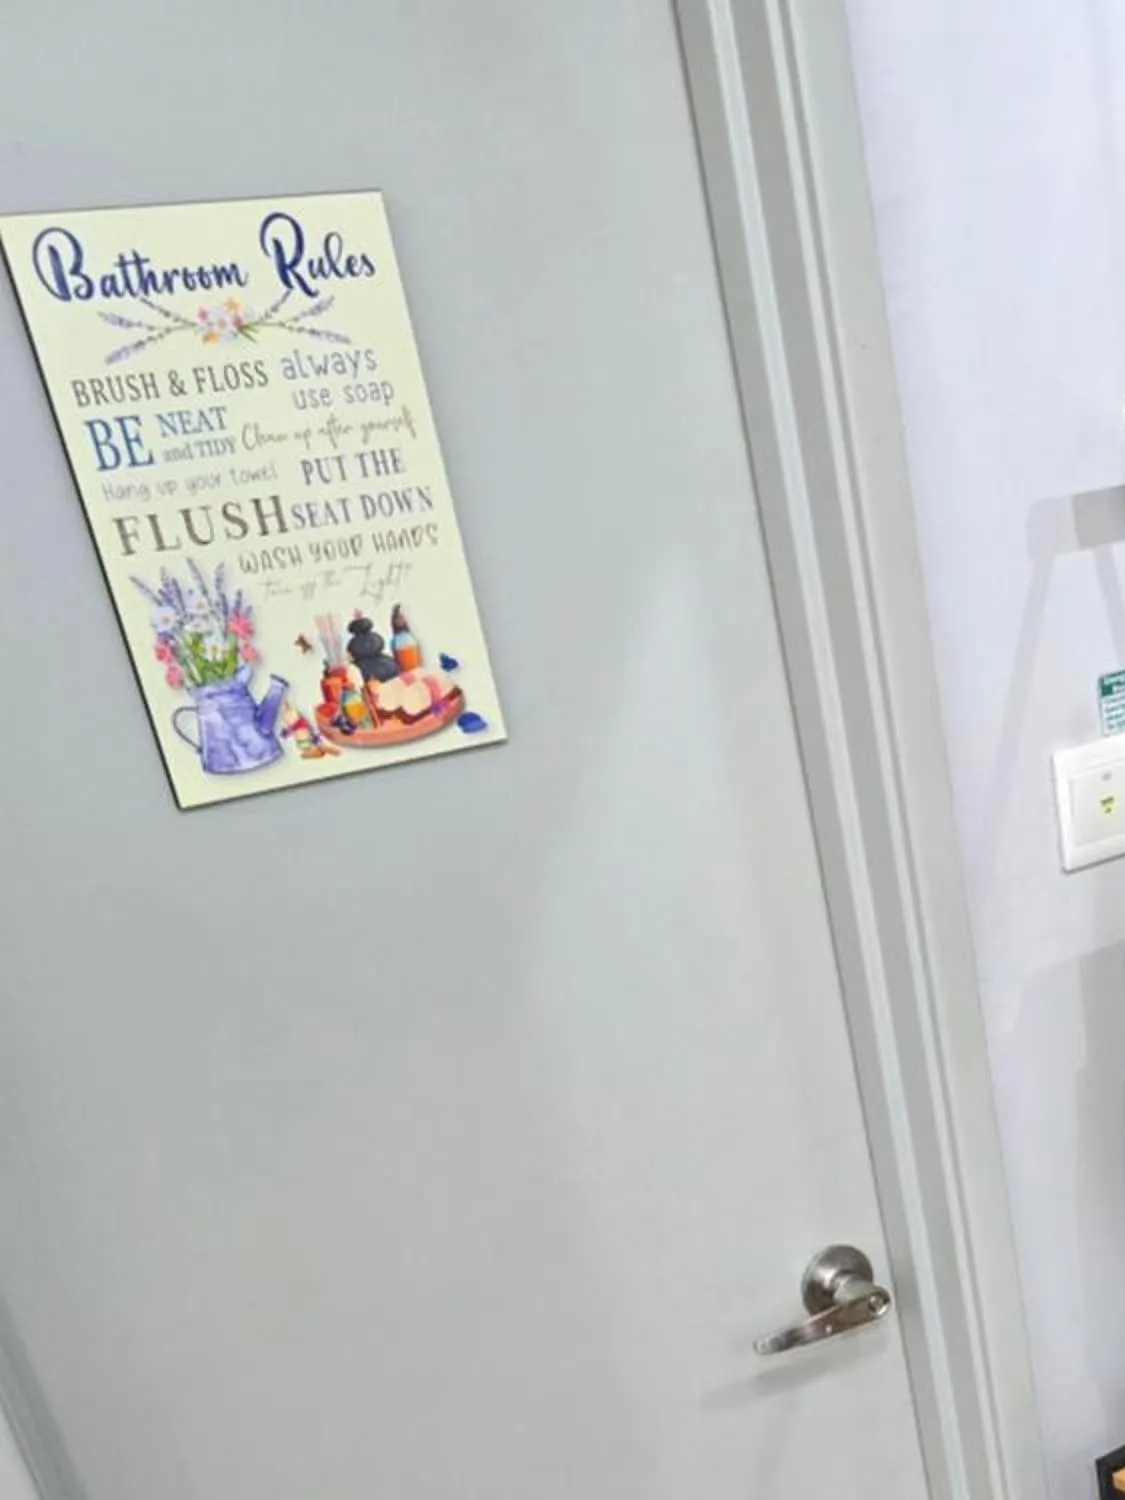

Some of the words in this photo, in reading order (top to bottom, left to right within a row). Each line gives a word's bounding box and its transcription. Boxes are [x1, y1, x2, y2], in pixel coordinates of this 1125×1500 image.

[32, 226, 248, 301] Bathroom
[260, 212, 376, 298] Rules
[281, 349, 378, 380] always
[70, 372, 160, 408] BRUSH
[167, 369, 188, 397] &
[192, 360, 269, 394] FLOSS
[291, 387, 334, 411] use
[342, 380, 395, 407] soap
[155, 406, 228, 438] NEAT
[83, 415, 155, 472] BE
[195, 436, 238, 458] TIDY
[300, 455, 349, 486] PUT
[354, 448, 407, 479] THE
[112, 495, 290, 557] FLUSH
[291, 498, 352, 530] SEAT
[359, 486, 434, 521] DOWN
[238, 544, 303, 575] WASH
